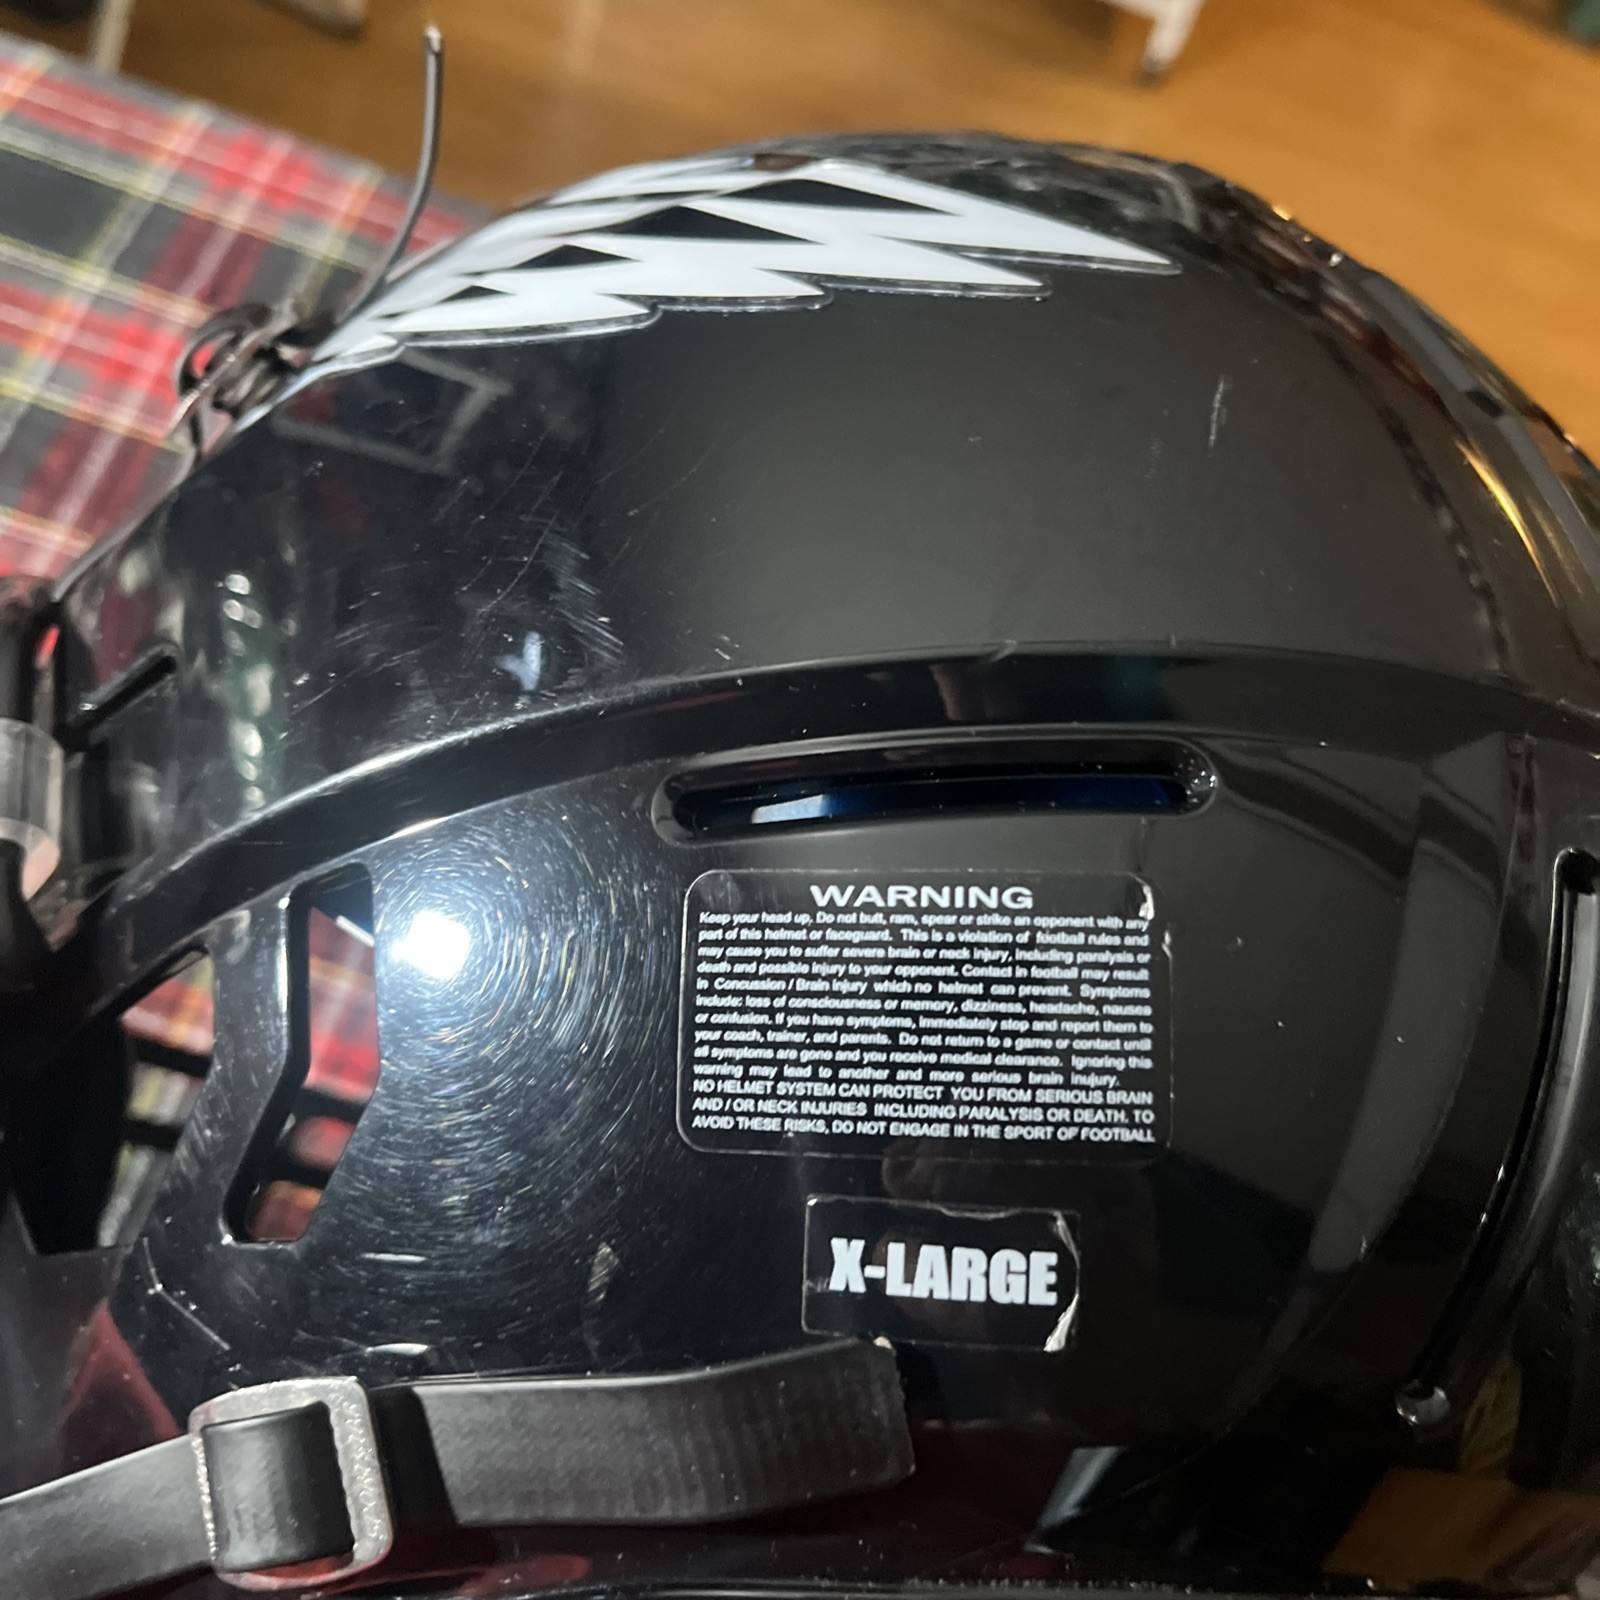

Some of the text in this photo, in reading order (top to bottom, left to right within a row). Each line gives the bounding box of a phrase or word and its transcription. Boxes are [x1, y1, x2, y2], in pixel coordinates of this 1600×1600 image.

[810, 885, 1034, 908] WARNING
[700, 911, 730, 925] Keep
[733, 913, 759, 926] your
[762, 911, 791, 923] head
[816, 911, 834, 924] Do
[837, 912, 857, 924] not
[921, 914, 956, 927] spear
[960, 915, 973, 925] or
[977, 913, 1010, 926] strike
[1014, 916, 1030, 926] an
[1034, 916, 1094, 929] opponent
[1098, 916, 1123, 929] with
[1126, 919, 1148, 932] any
[699, 929, 723, 943] part
[725, 927, 738, 940] of
[740, 928, 762, 940] this
[765, 928, 807, 940] helmet
[810, 930, 823, 940] or
[901, 929, 929, 941] This
[932, 929, 943, 942] is
[946, 932, 955, 942] a
[959, 930, 1012, 943] violation
[1016, 931, 1029, 943] of
[1036, 931, 1085, 944] football
[1088, 933, 1120, 945] rules
[1125, 934, 1148, 946] and
[698, 947, 724, 959] may
[726, 947, 762, 957] cause
[765, 947, 787, 959] you
[790, 946, 802, 957] to
[805, 945, 839, 957] suffer
[843, 948, 885, 958] severe
[888, 946, 919, 958] brain
[923, 949, 937, 958] or
[940, 947, 970, 959] neck
[1077, 950, 1134, 965] paralysis
[1137, 953, 1151, 963] or
[697, 961, 731, 973] death
[734, 961, 756, 973] and
[759, 961, 809, 975] possible
[812, 962, 844, 977] injury
[849, 963, 861, 974] to
[864, 965, 892, 977] your
[962, 965, 1012, 977] Contact
[1016, 965, 1028, 977] in
[1031, 966, 1078, 979] football
[1082, 969, 1110, 982] may
[1113, 968, 1148, 980] result
[697, 977, 708, 989] in
[714, 978, 785, 990] Concussion
[796, 979, 830, 991] Brain
[874, 980, 912, 992] which
[914, 983, 932, 993] no
[938, 981, 983, 994] helmet
[990, 985, 1015, 995] can
[1080, 984, 1150, 1000] Symptoms
[746, 995, 770, 1007] loss
[773, 995, 786, 1008] of
[788, 996, 881, 1009] consciousness
[884, 1000, 898, 1010] or
[695, 1013, 708, 1023] or
[775, 1012, 784, 1024] If
[787, 1014, 809, 1027] you
[813, 1013, 844, 1026] have
[1000, 1019, 1029, 1032] stop
[1032, 1019, 1057, 1031] and
[1061, 1021, 1099, 1034] report
[1103, 1020, 1136, 1032] them
[1140, 1022, 1153, 1033] to
[695, 1031, 722, 1043] your
[813, 1031, 837, 1043] and
[900, 1032, 918, 1045] Do
[921, 1034, 942, 1046] not
[945, 1035, 984, 1046] return
[987, 1036, 1000, 1047] to
[1003, 1038, 1012, 1047] a
[1015, 1038, 1052, 1051] game
[1056, 1039, 1069, 1049] or
[1073, 1038, 1120, 1050] contact
[1124, 1038, 1151, 1050] until
[695, 1045, 709, 1057] all
[711, 1046, 774, 1060] symptoms
[777, 1049, 798, 1060] are
[801, 1050, 832, 1062] gone
[835, 1049, 860, 1061] and
[863, 1051, 887, 1064] you
[890, 1051, 937, 1063] receive
[940, 1052, 991, 1065] medical
[1129, 1056, 1152, 1068] this
[693, 1062, 743, 1078] warning
[750, 1066, 777, 1079] may
[784, 1064, 811, 1077] lead
[819, 1066, 832, 1078] to
[839, 1067, 889, 1079] another
[896, 1068, 922, 1081] and
[930, 1071, 964, 1082] more
[972, 1070, 1021, 1083] serious
[1029, 1072, 1063, 1084] brain
[693, 1079, 1153, 1104] NO HELMET SYSTEM CAN PROTECT YOU FROM SERIOUS BRAIN
[692, 1097, 723, 1111] AND
[733, 1098, 755, 1112] OR
[758, 1099, 798, 1114] NECK
[874, 1103, 956, 1118] INCLUDING
[959, 1106, 1044, 1120] PARALYSIS
[1047, 1108, 1070, 1122] OR
[1134, 1110, 1154, 1124] TO
[692, 1115, 734, 1129] AVOID
[737, 1116, 782, 1131] THESE
[832, 1120, 853, 1133] DO
[857, 1121, 887, 1134] NOT
[889, 1122, 950, 1137] ENGAGE
[954, 1125, 969, 1137] IN
[972, 1124, 1000, 1138] THE
[1004, 1126, 1054, 1139] SPORT
[1057, 1127, 1079, 1140] OF
[1081, 1127, 1155, 1142] FOOTBALL
[828, 1237, 1059, 1306] X-LARGE
